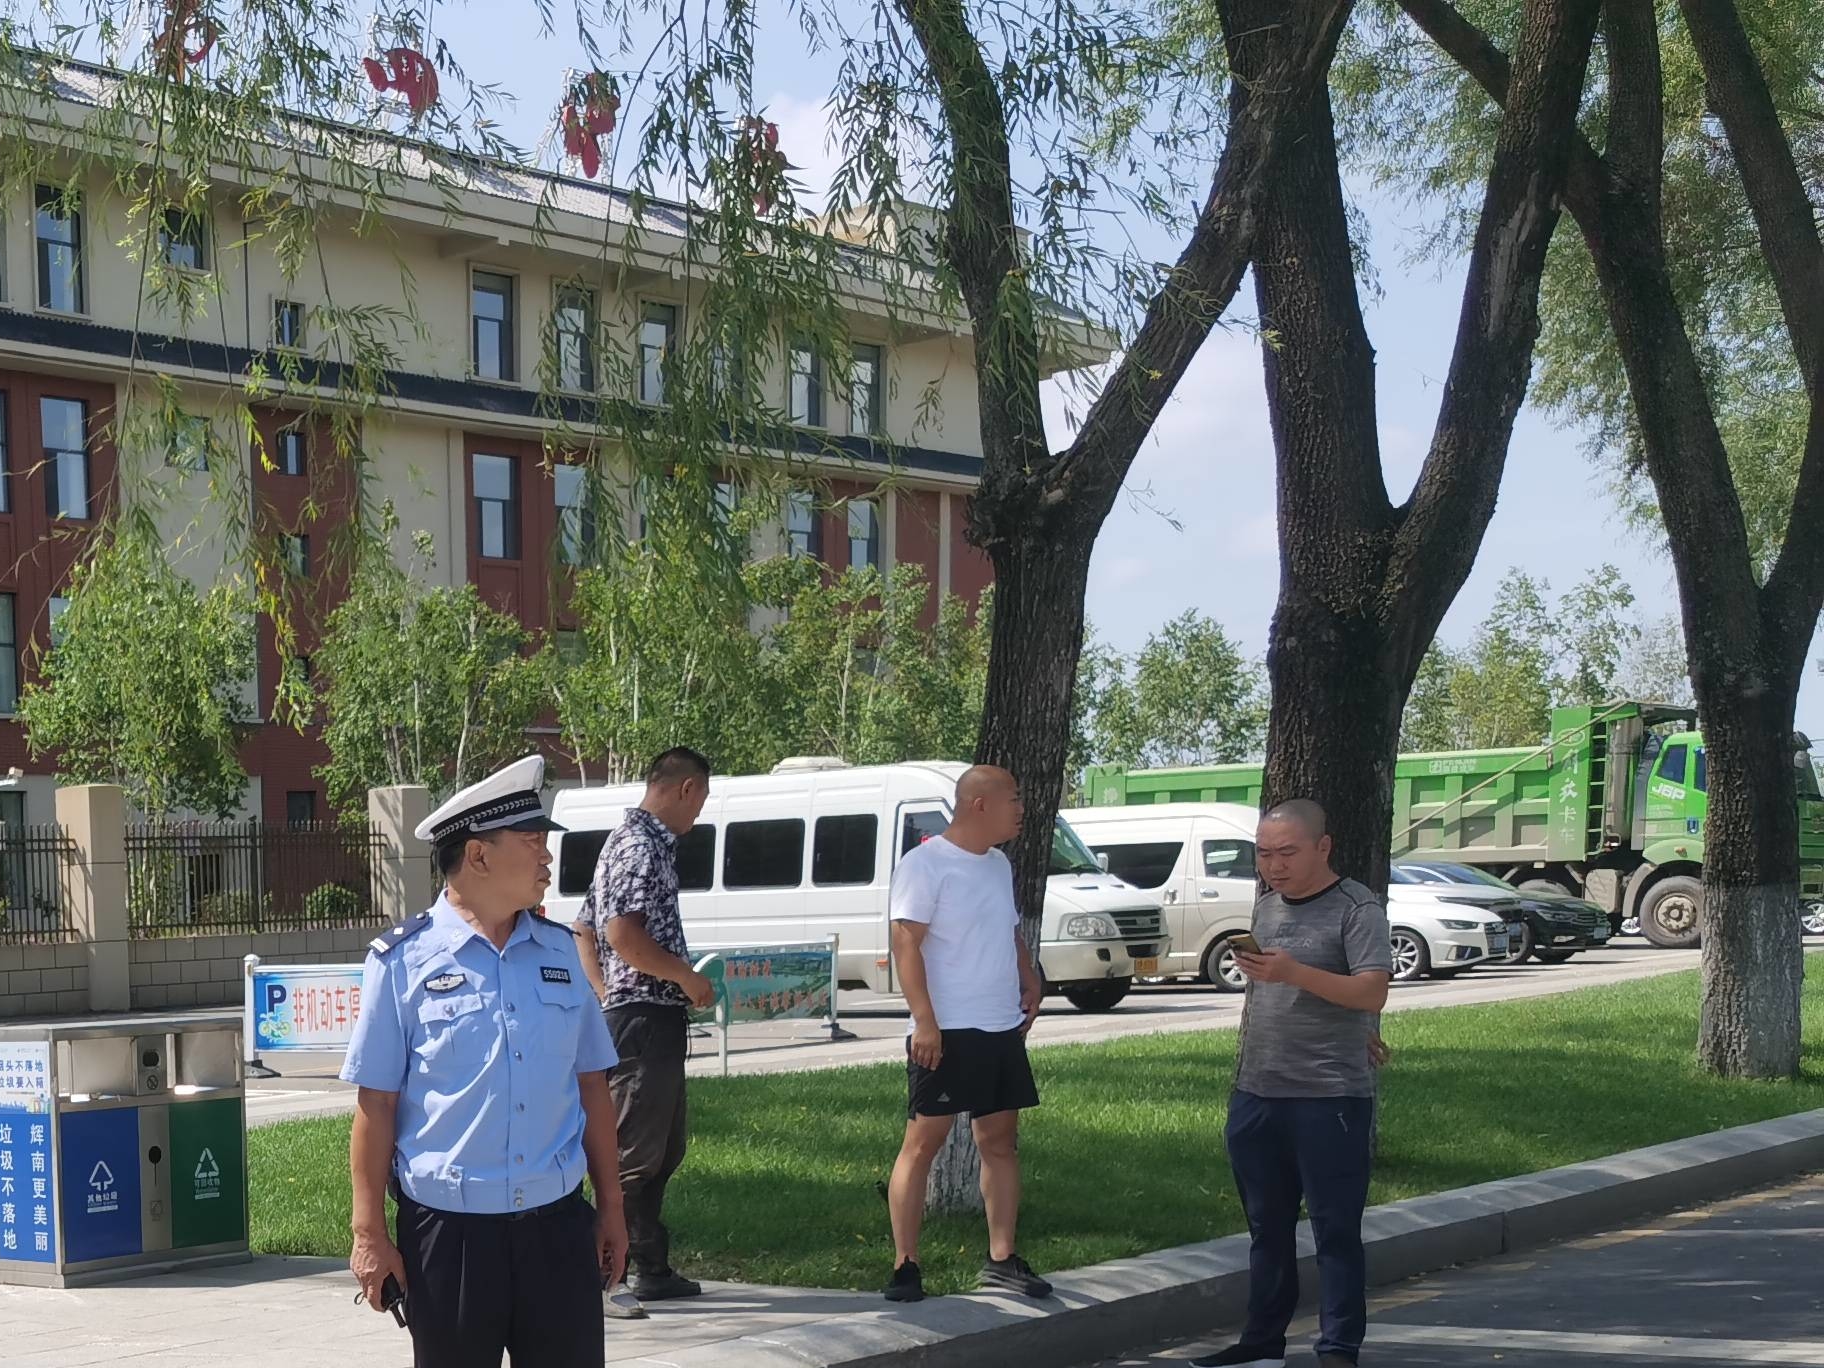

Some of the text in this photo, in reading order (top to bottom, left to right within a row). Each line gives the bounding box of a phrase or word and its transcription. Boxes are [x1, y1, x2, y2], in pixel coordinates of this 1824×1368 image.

[266, 984, 287, 1012] P
[0, 1123, 18, 1250] 垃圾不落地
[30, 1123, 48, 1251] 辉南更美丽
